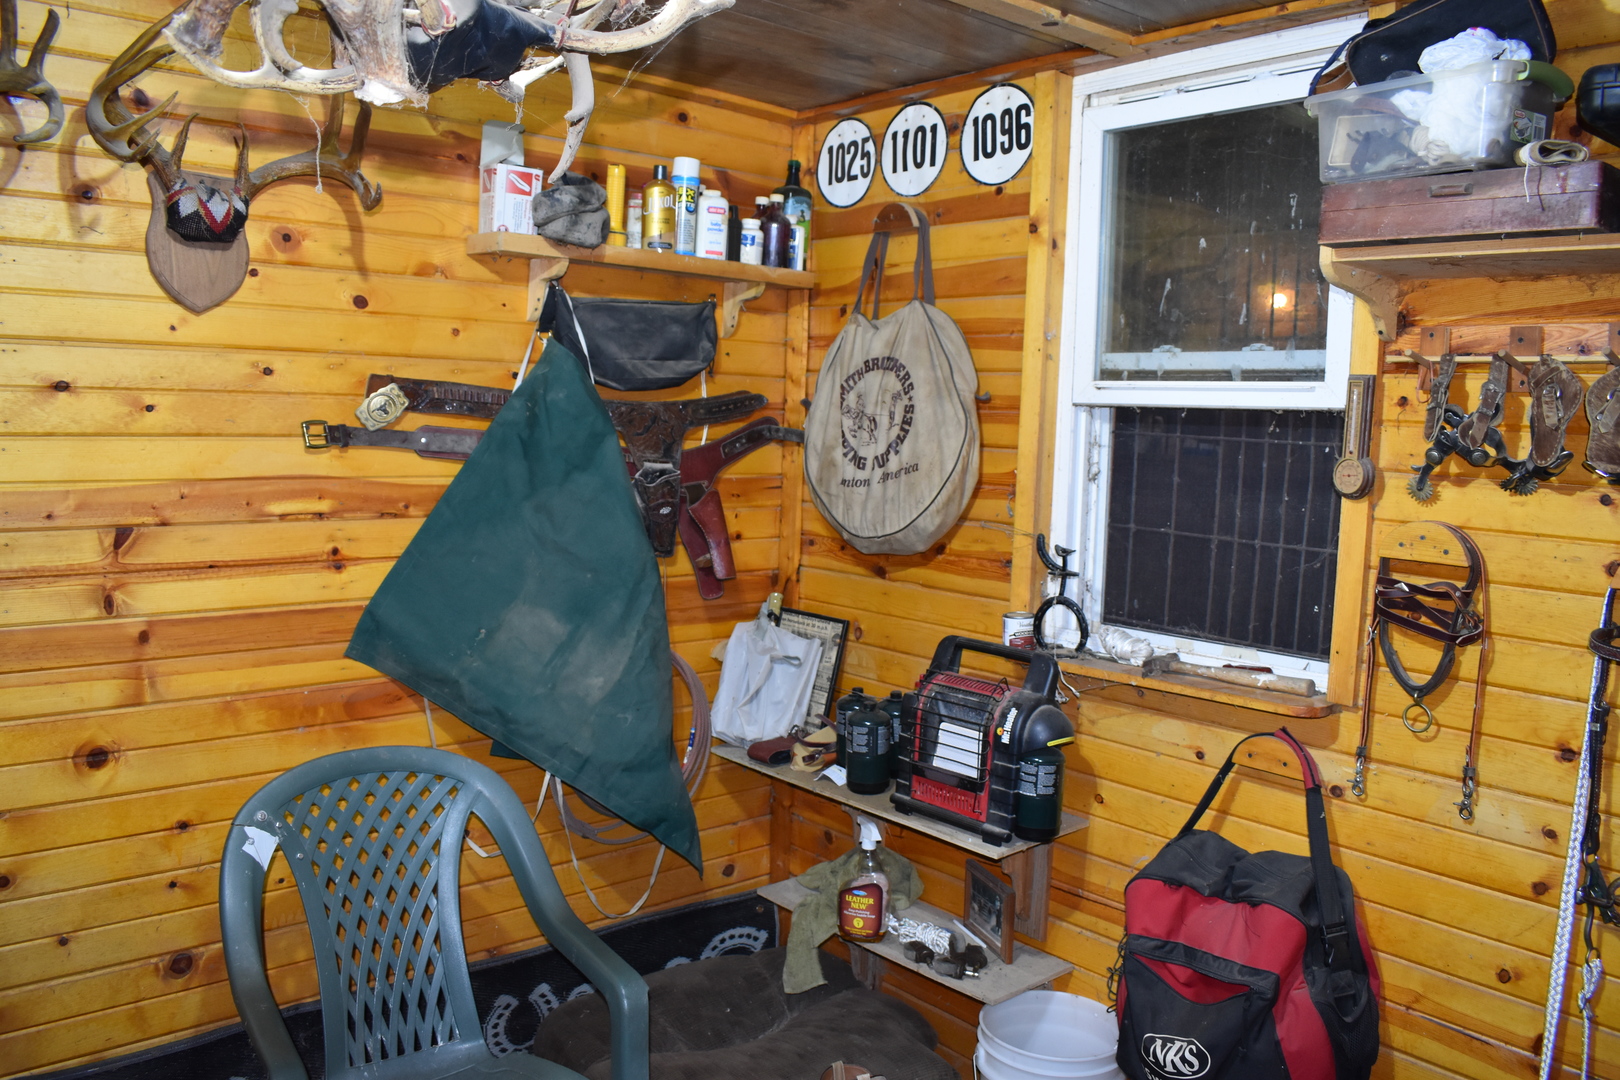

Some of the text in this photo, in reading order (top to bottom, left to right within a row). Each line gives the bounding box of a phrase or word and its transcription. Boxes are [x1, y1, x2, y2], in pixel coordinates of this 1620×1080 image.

[891, 123, 938, 174] 1101
[972, 103, 1032, 162] 1096
[827, 136, 871, 187] 1025
[840, 367, 865, 410] MITH
[1000, 707, 1018, 745] Mr. Heater
[846, 894, 874, 904] LEATHER
[851, 902, 867, 910] NEW
[1148, 1038, 1200, 1075] NRS
